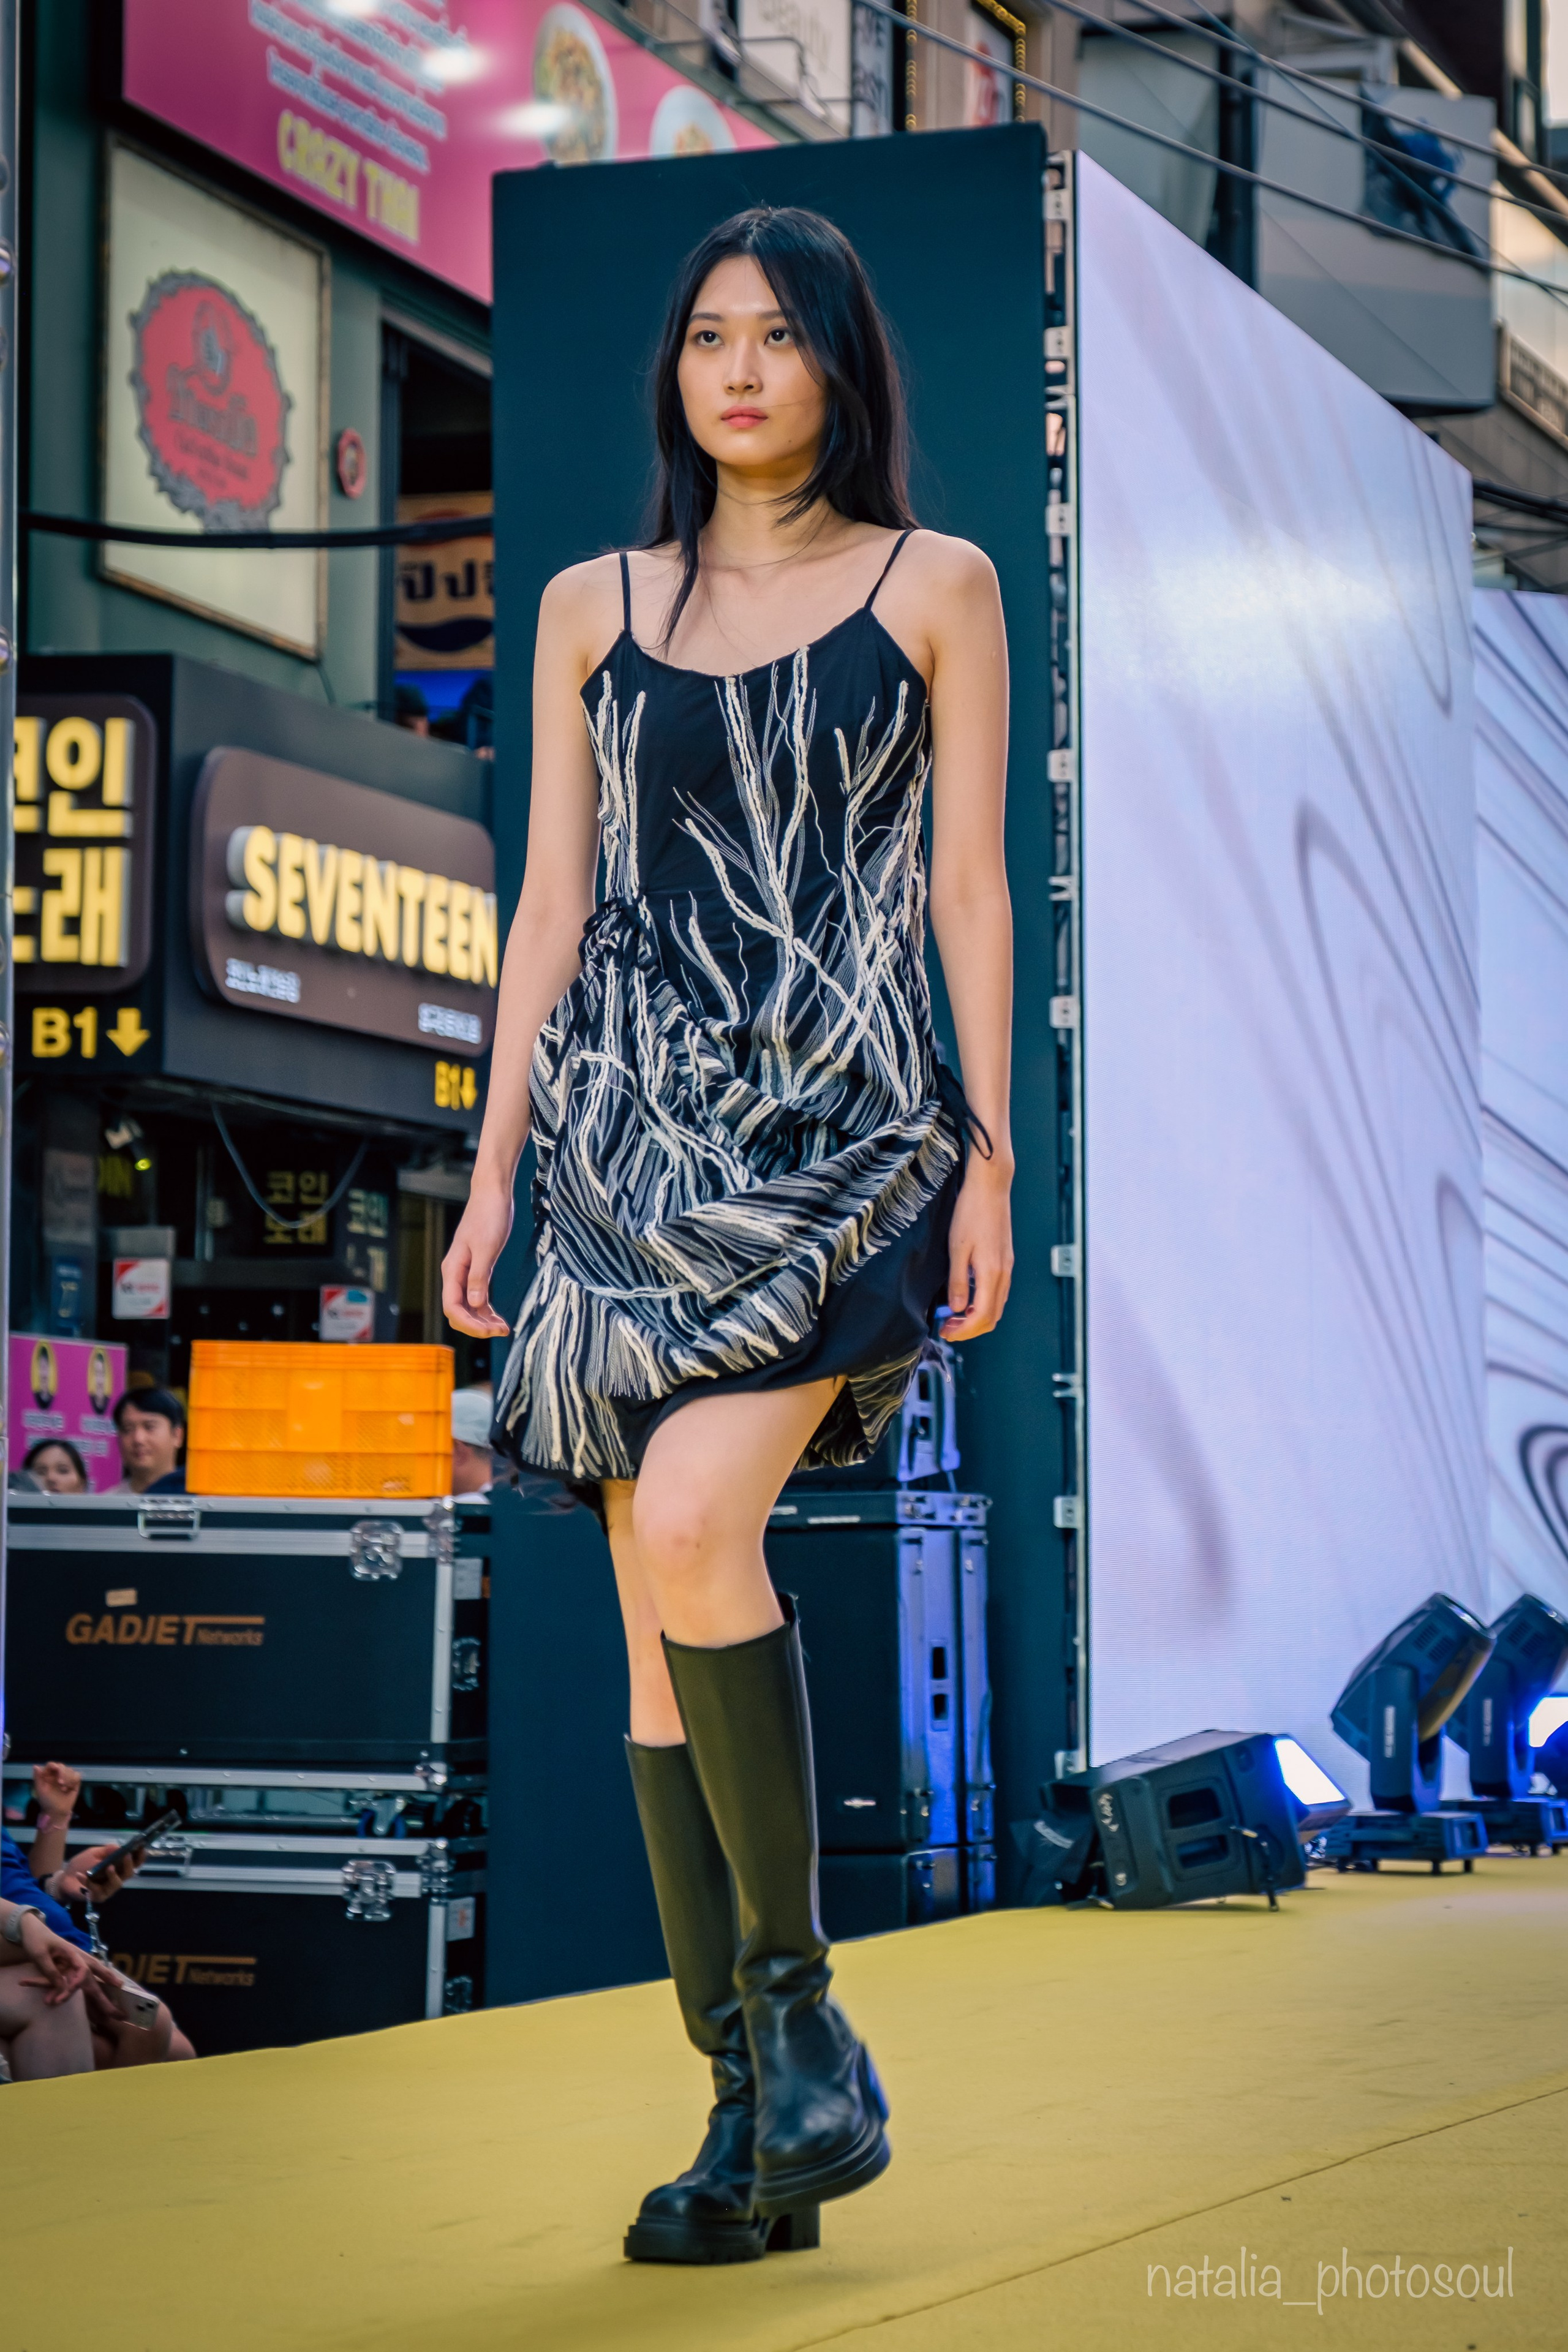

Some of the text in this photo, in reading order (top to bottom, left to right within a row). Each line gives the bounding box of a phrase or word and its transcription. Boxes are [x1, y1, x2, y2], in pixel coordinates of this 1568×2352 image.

[225, 824, 498, 989] SEVENTEEN
[31, 1006, 99, 1059] B1
[434, 1060, 461, 1110] B1
[265, 1170, 329, 1205] 코인
[65, 1613, 264, 1646] GADJET
